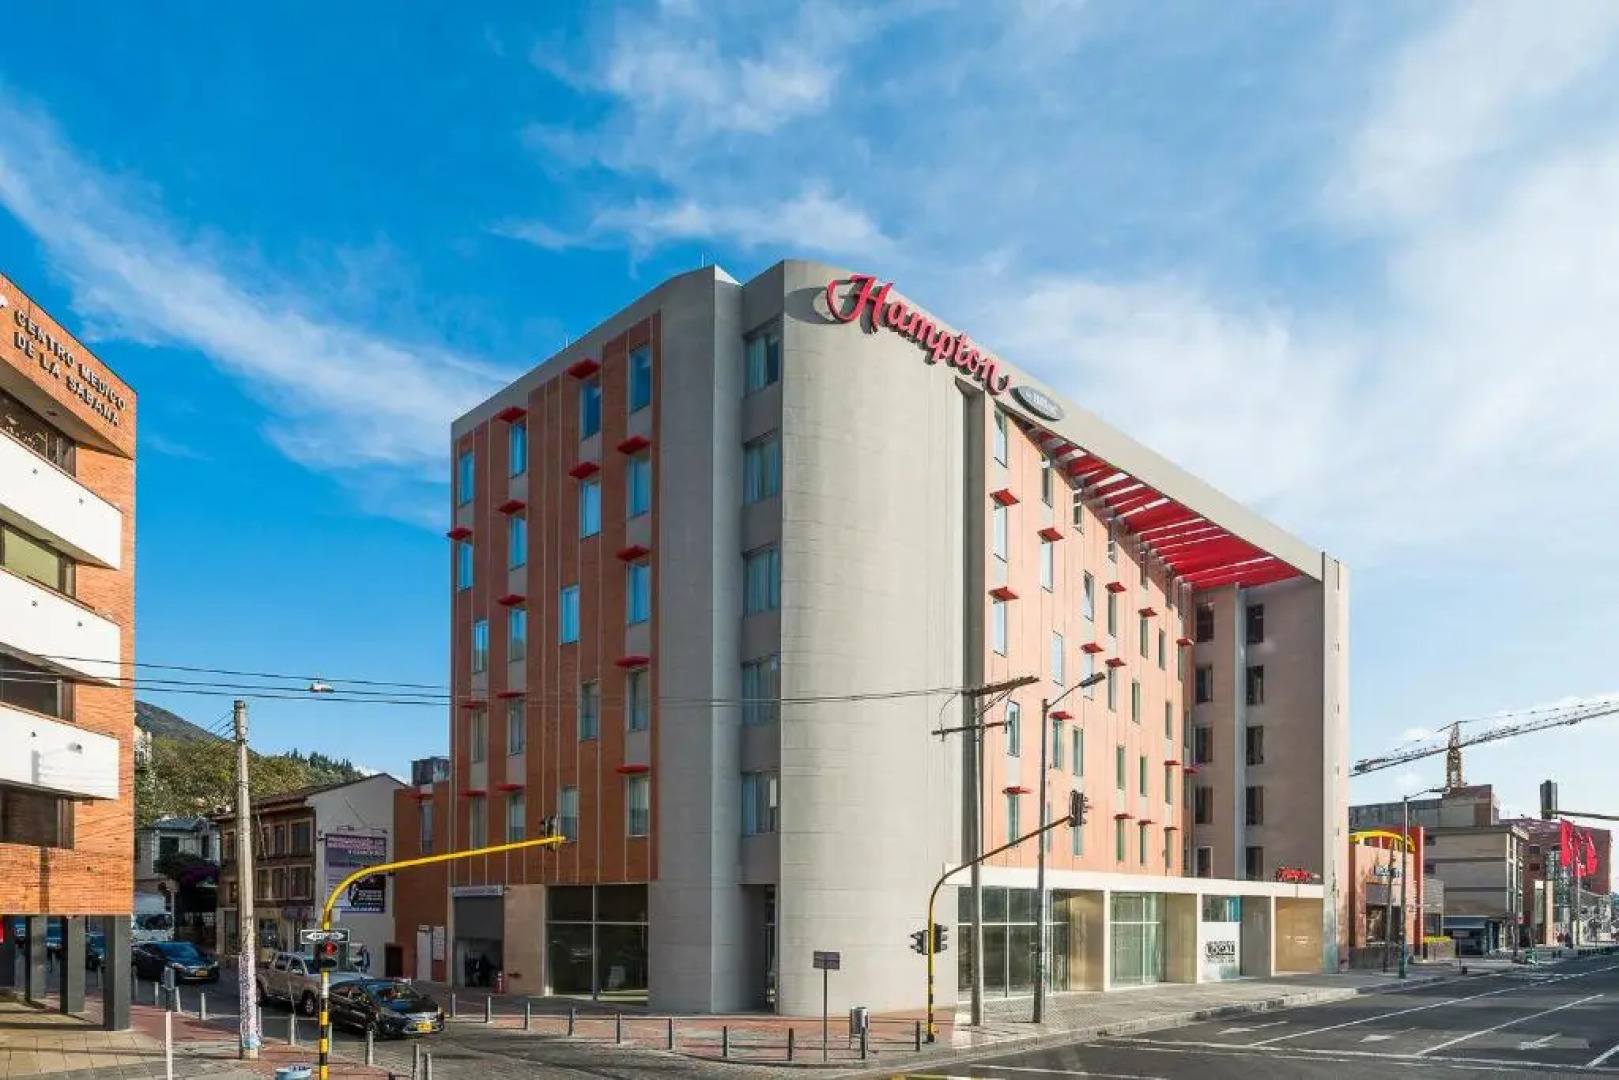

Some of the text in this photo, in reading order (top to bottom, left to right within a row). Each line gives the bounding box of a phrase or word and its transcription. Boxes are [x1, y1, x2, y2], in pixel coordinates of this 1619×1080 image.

[14, 310, 126, 410] CENTRO MEDICO
[14, 331, 119, 426] DE LA SABANA
[827, 273, 1013, 397] Hampton
